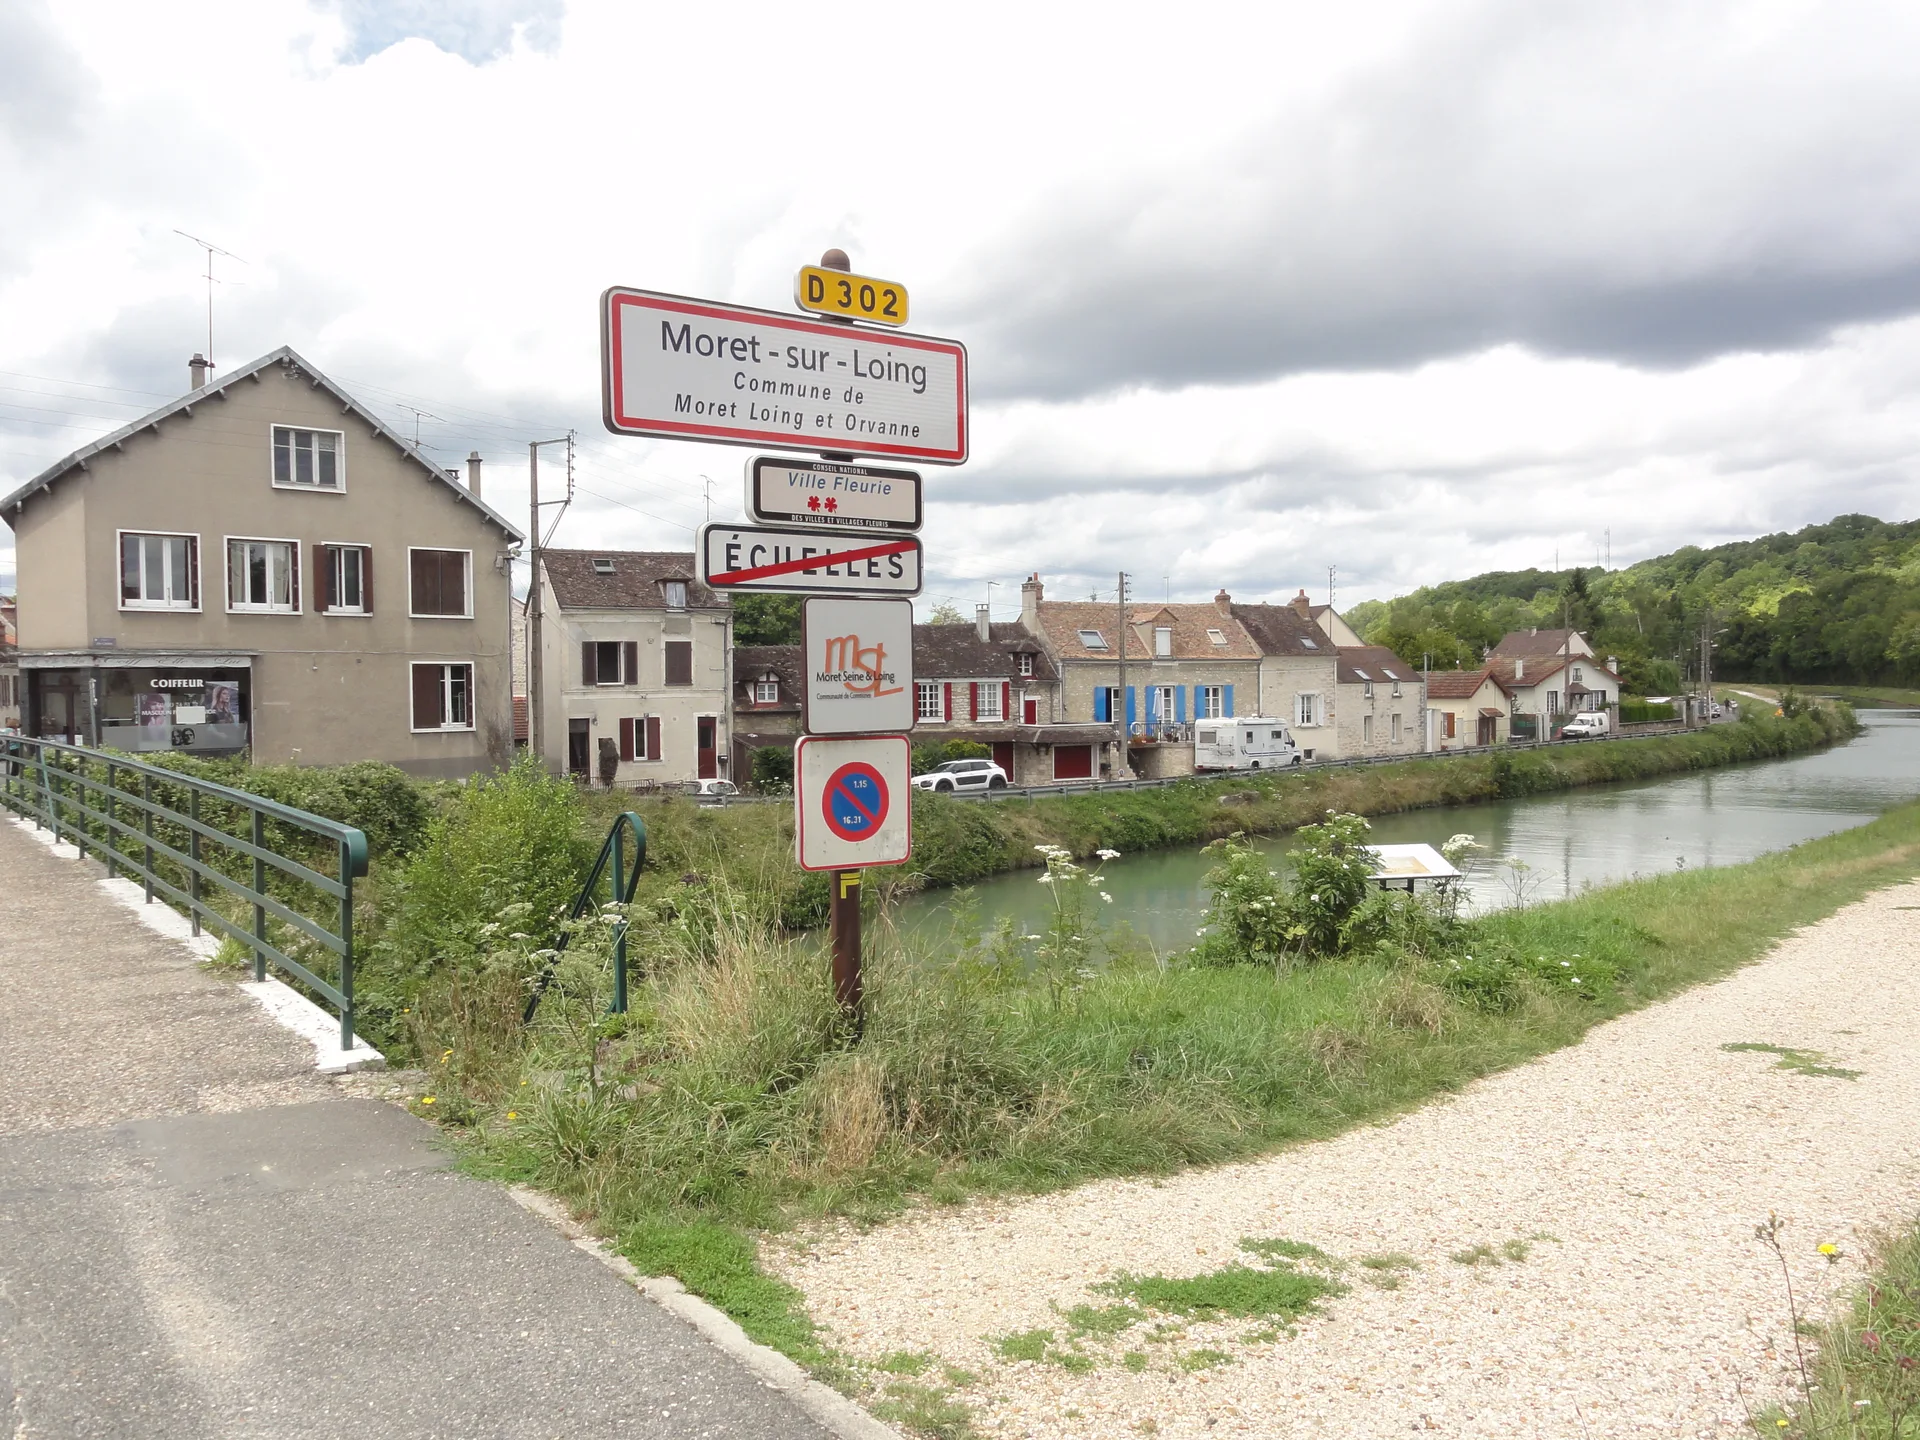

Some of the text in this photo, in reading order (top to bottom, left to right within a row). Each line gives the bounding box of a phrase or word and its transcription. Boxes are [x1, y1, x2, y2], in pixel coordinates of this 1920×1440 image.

[808, 274, 899, 317] D 302
[733, 371, 865, 405] Commune de
[674, 393, 921, 439] Moret Loing et Orvanne
[812, 463, 868, 476] CONSEIL NATIONAL
[787, 472, 892, 496] Ville Fleurie
[791, 514, 889, 528] DES VILLES ET VILLAGES FLEURIS
[725, 533, 904, 580] ÉCUELLES
[150, 678, 205, 688] COIFFEUR
[816, 670, 895, 684] Moret Seine & Loing
[853, 780, 868, 788] 1.15
[843, 816, 861, 824] 16.31
